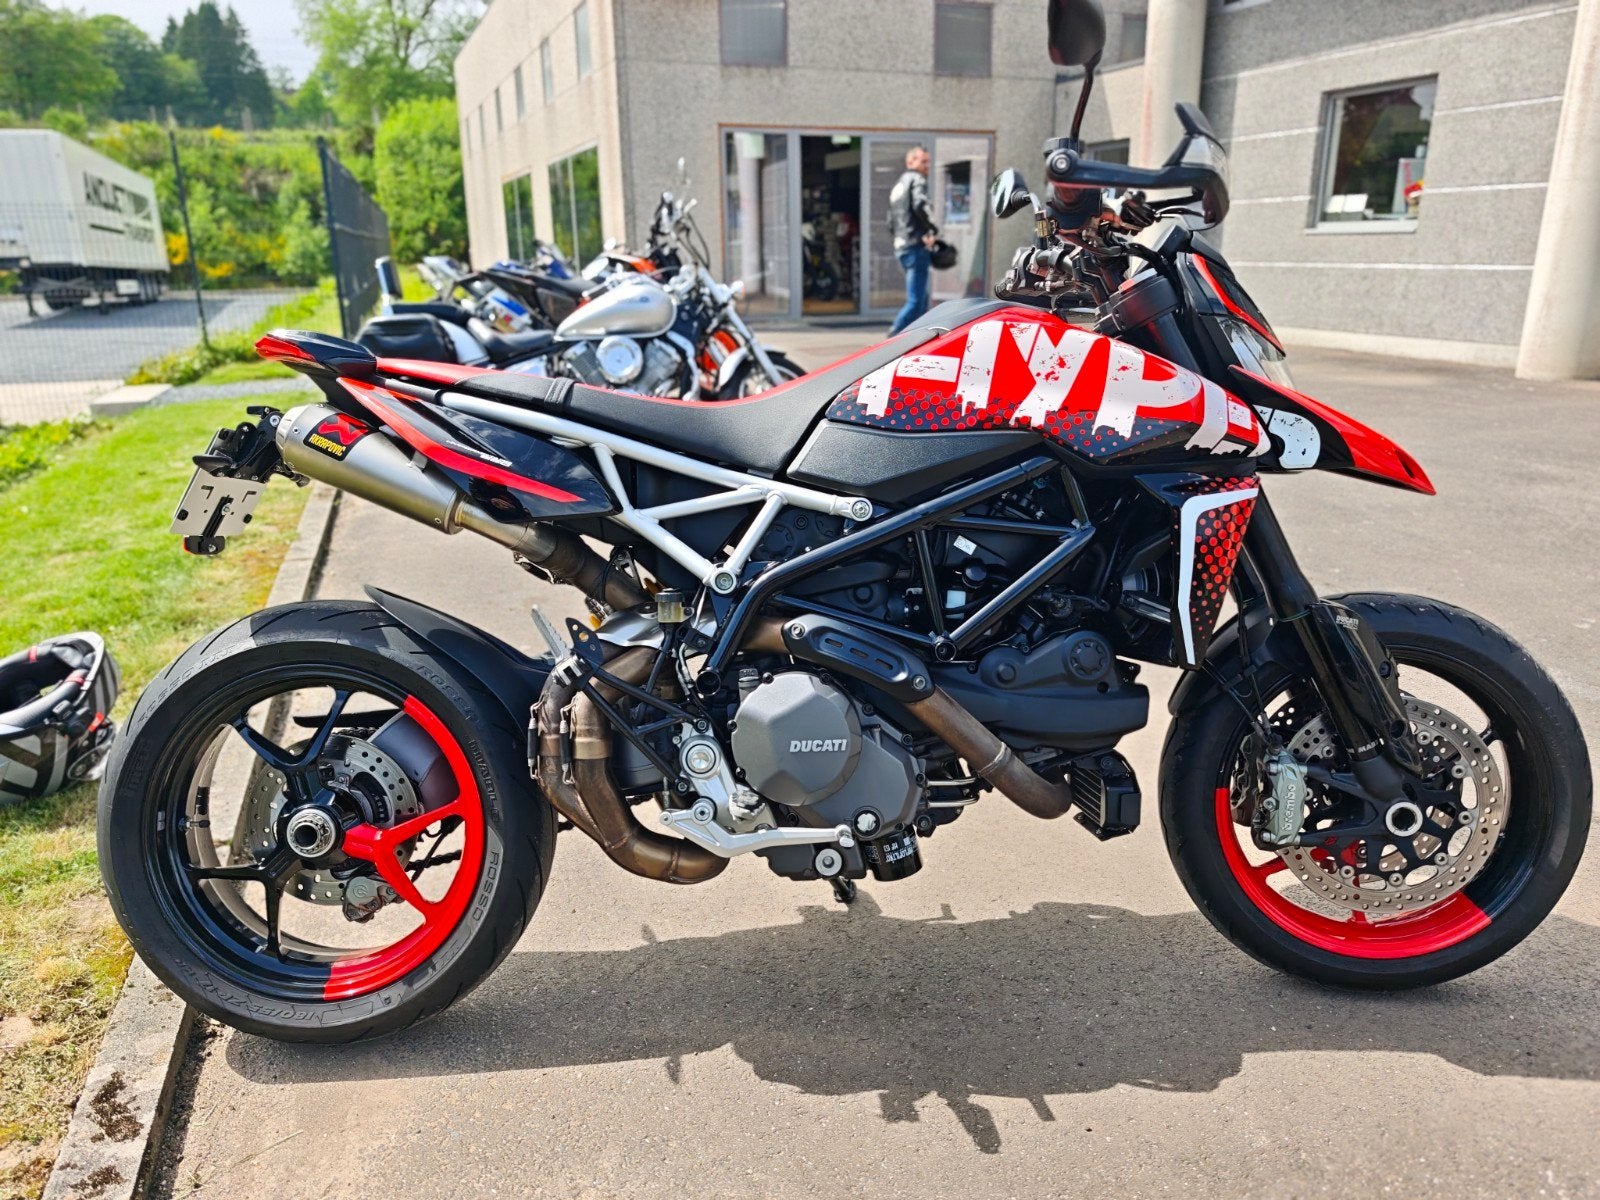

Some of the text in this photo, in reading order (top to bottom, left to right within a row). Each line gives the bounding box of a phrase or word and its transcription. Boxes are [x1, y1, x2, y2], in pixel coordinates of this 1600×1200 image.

[789, 739, 848, 752] DUCATI
[1281, 784, 1297, 832] brembo
[473, 851, 500, 921] ROSSO
